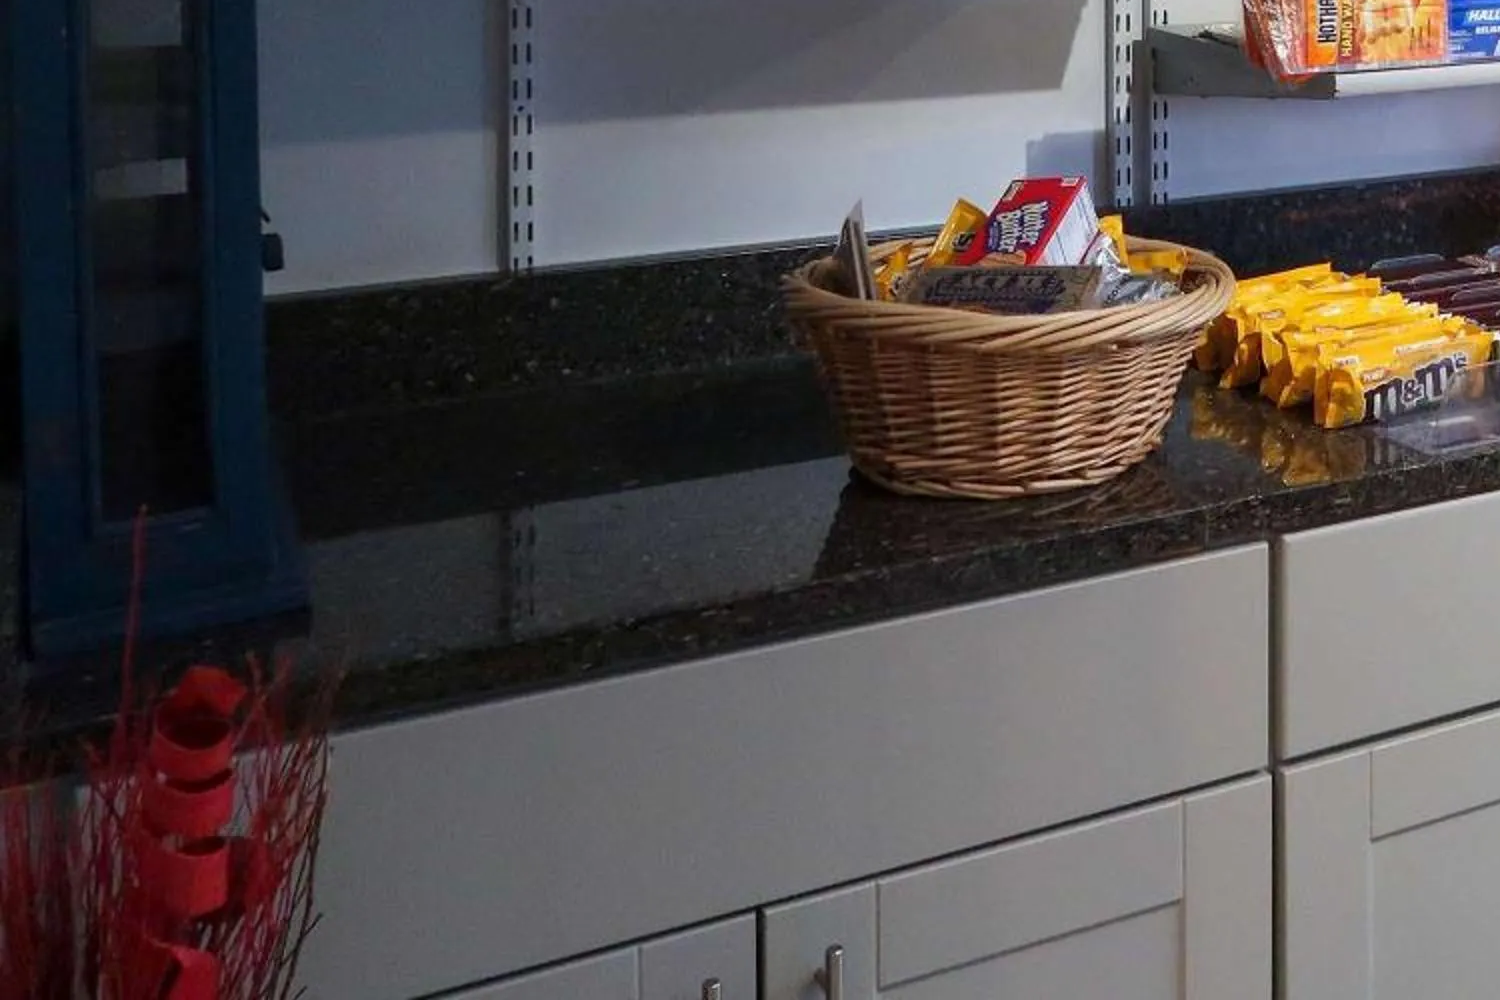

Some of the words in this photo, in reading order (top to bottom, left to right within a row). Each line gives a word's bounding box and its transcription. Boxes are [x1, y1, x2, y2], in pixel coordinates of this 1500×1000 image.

[1339, 21, 1354, 58] HAND
[996, 209, 1021, 253] Butter
[1020, 201, 1049, 246] Nutter
